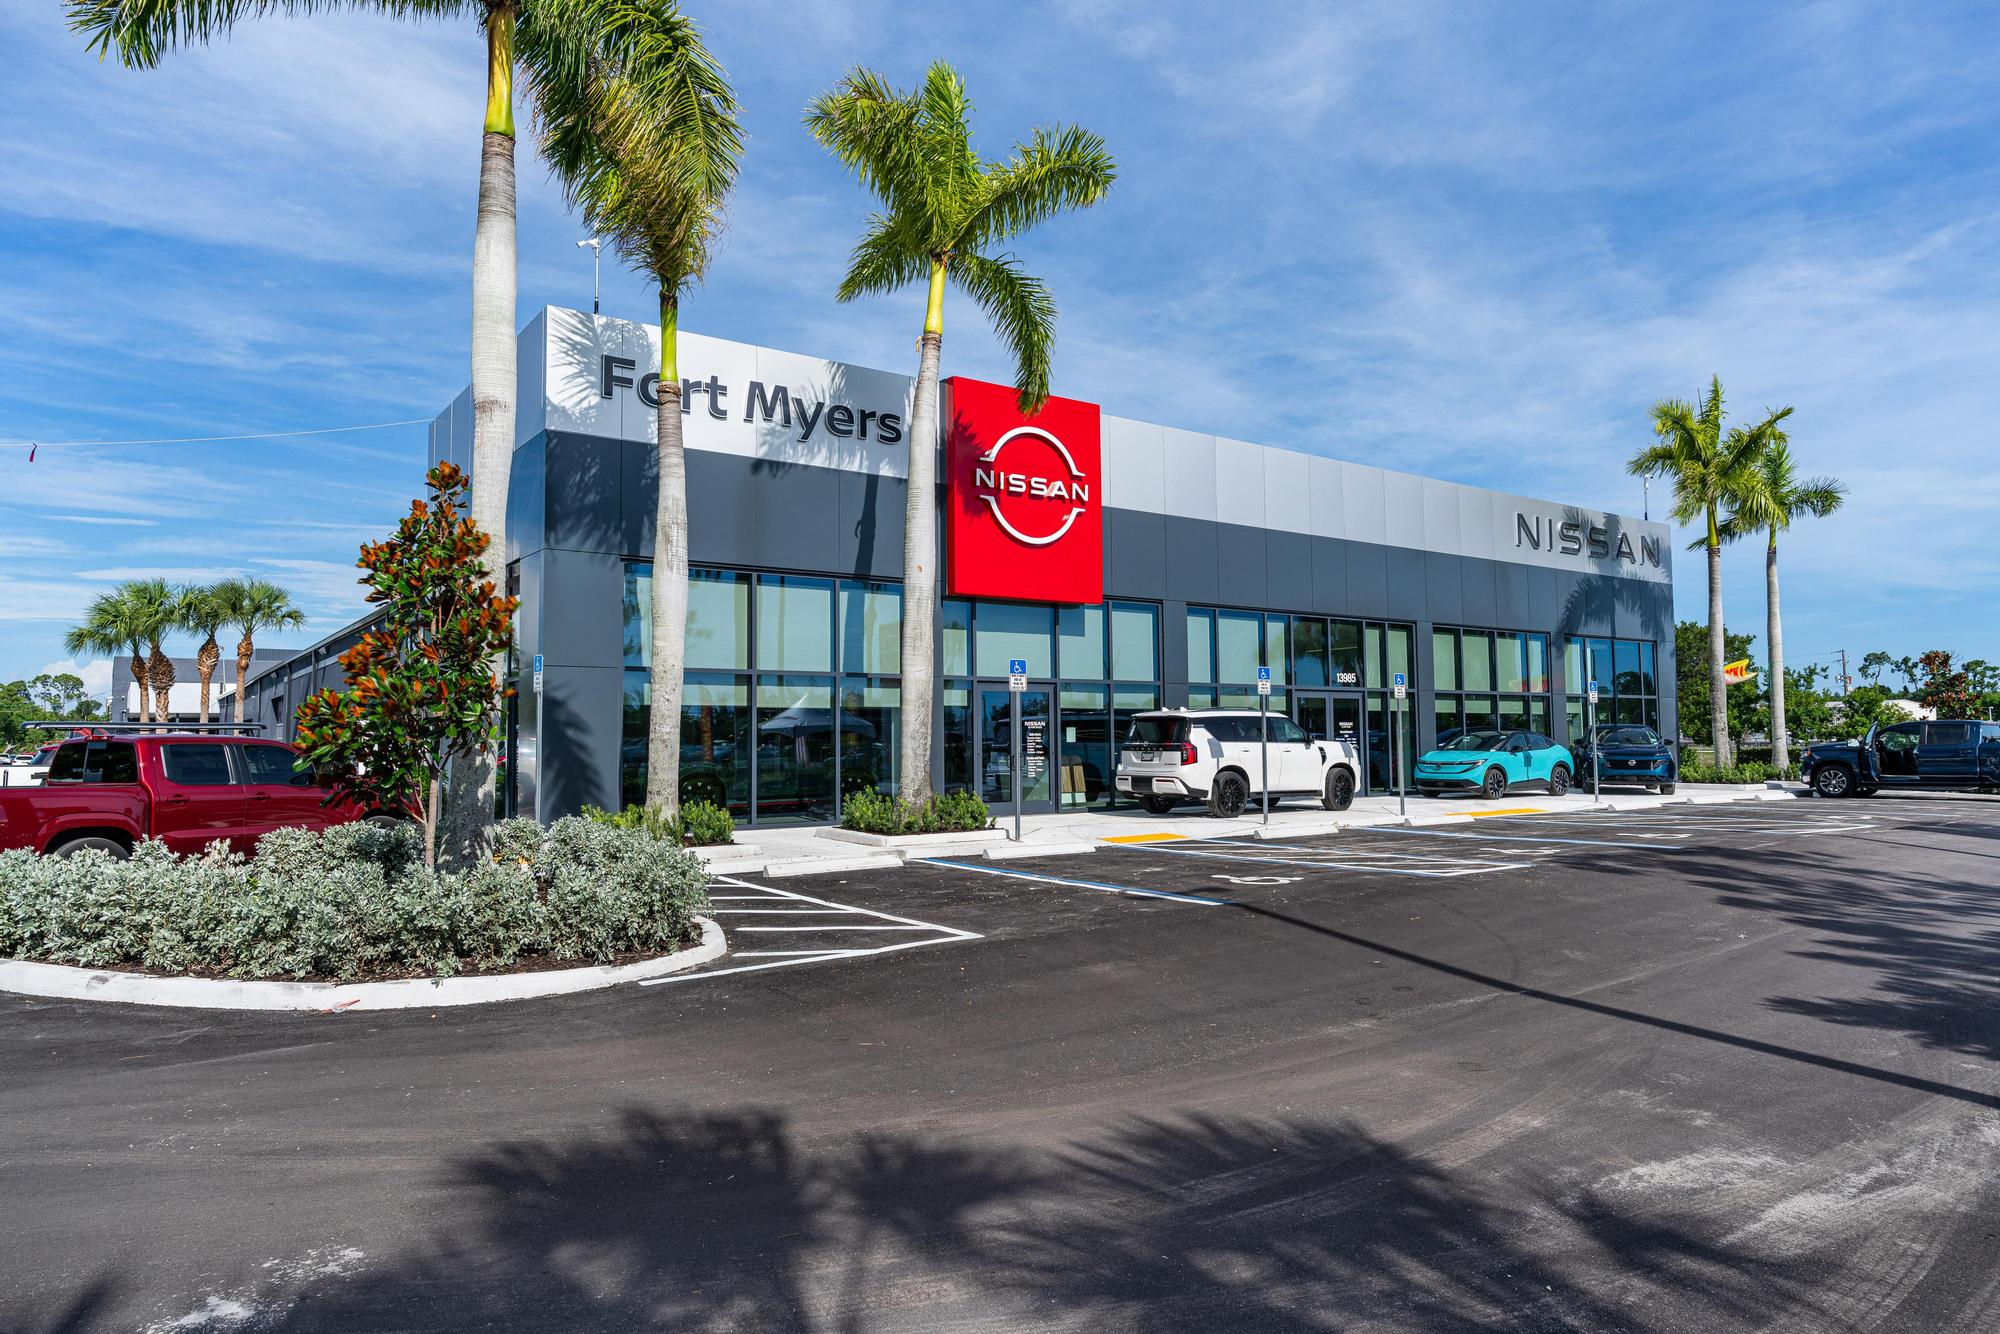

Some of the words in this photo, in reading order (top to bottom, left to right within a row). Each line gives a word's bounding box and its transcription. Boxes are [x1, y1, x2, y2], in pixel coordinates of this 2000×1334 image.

[601, 353, 728, 421] Fort
[743, 379, 903, 445] Myers
[976, 467, 1089, 502] NISSAN
[1515, 512, 1661, 568] NISSAN
[1336, 672, 1357, 683] 13985
